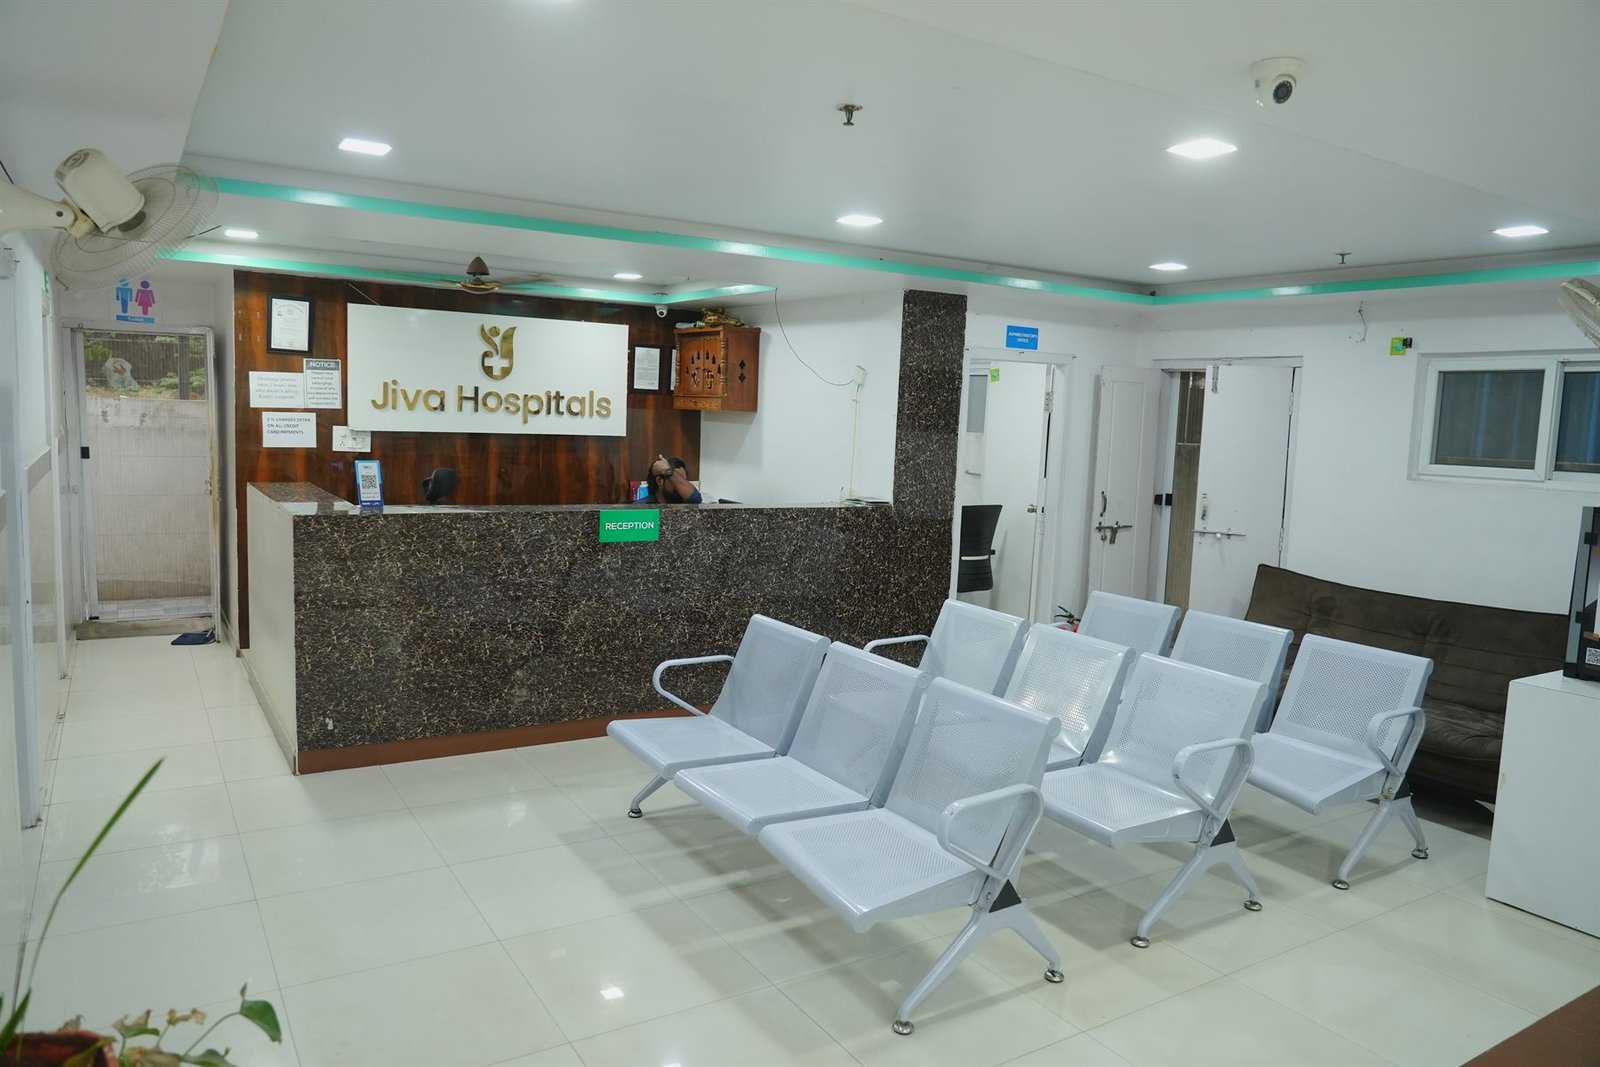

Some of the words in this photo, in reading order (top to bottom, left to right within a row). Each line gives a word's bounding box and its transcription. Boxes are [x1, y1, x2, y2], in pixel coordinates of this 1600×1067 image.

[371, 379, 446, 412] Jiva
[456, 385, 612, 424] Hospitals
[605, 521, 655, 530] RECEPTION
